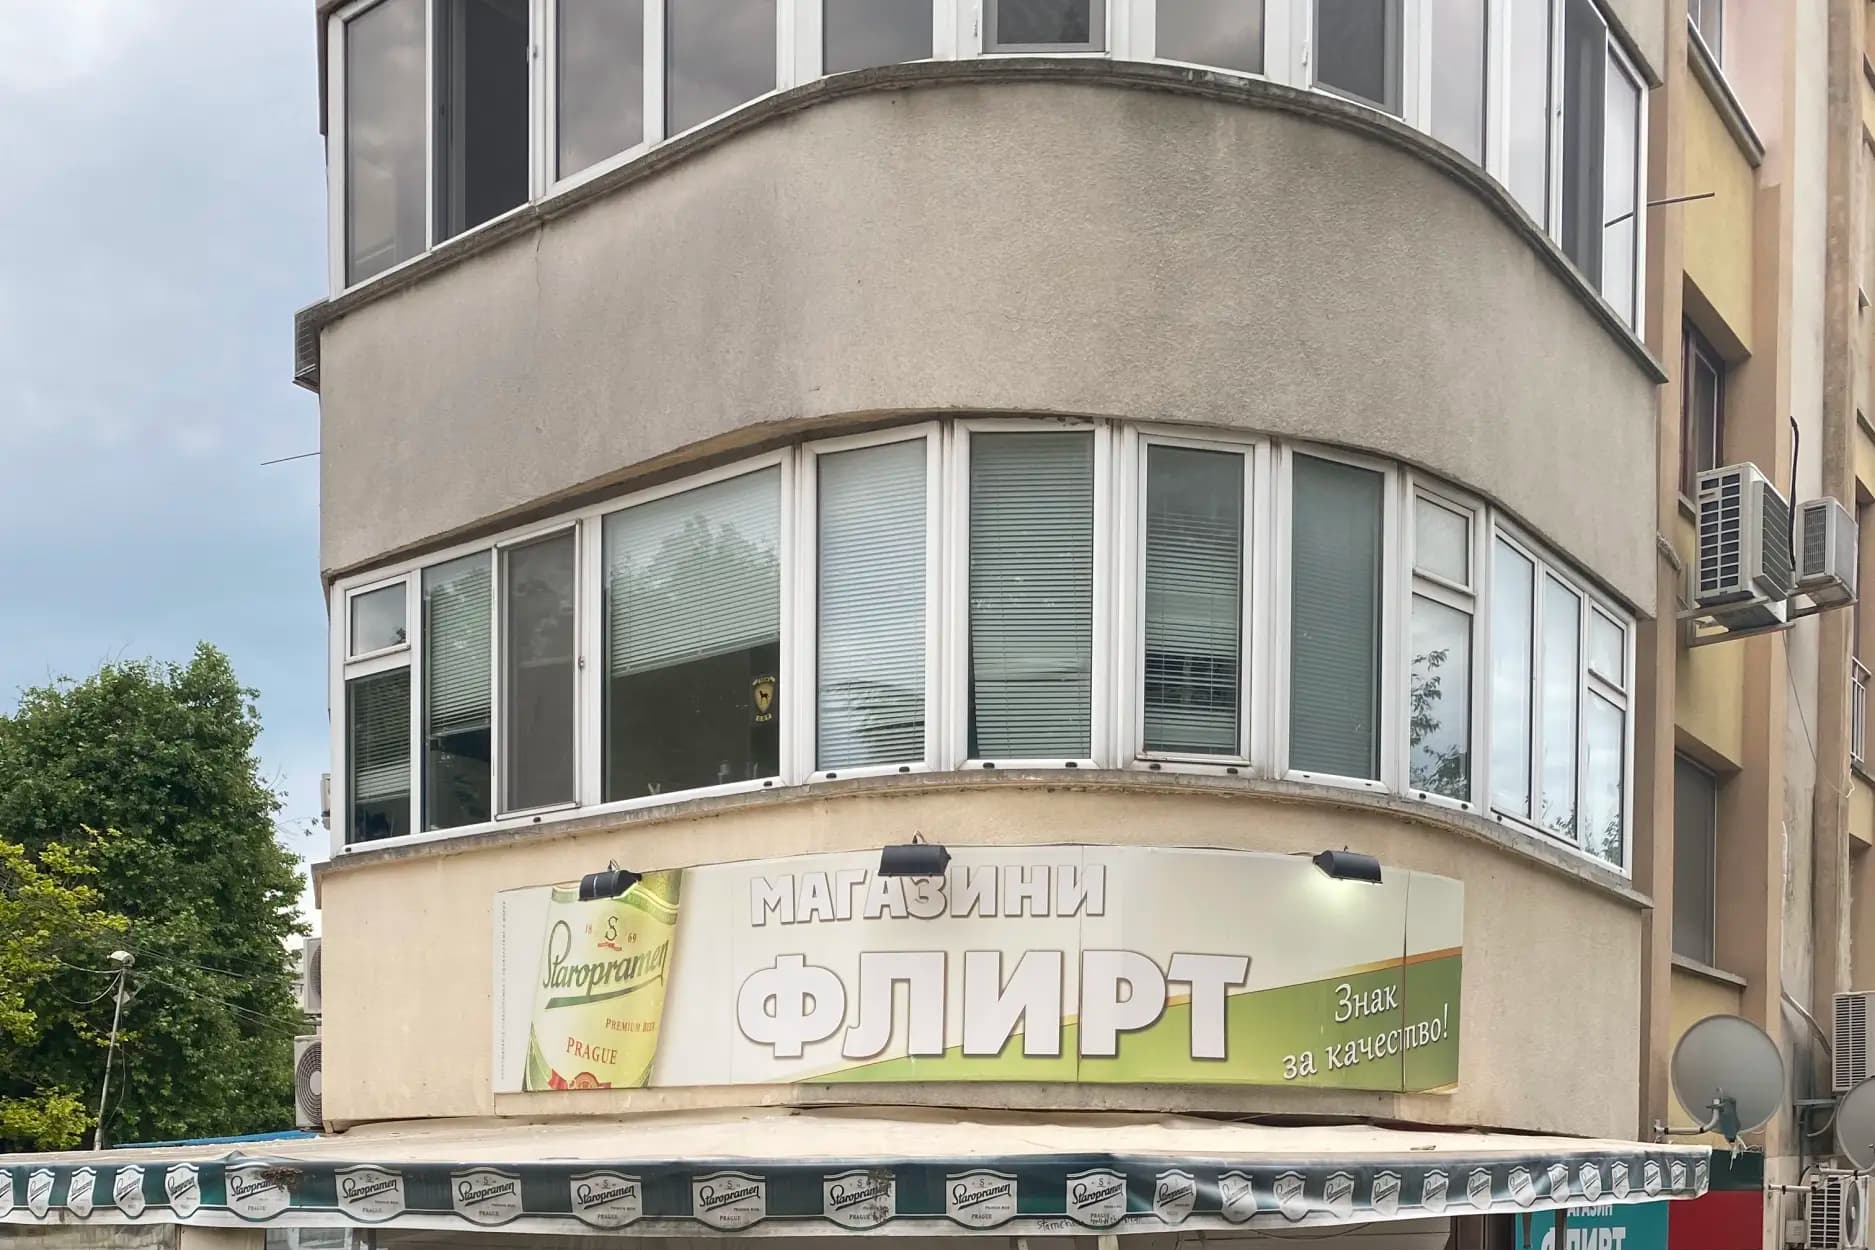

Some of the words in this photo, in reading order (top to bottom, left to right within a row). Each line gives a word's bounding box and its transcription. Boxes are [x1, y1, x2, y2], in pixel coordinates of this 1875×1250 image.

[750, 863, 1106, 927] МАГАЗИНИ
[542, 920, 669, 998] Staropramen
[737, 949, 1250, 1062] ФЛИРТ
[1334, 982, 1399, 1023] Знак
[605, 1017, 641, 1033] PREMIUM
[566, 1036, 619, 1065] PRAGUE
[1283, 1051, 1317, 1080] за
[1327, 1003, 1450, 1071] качество!
[342, 1177, 398, 1199] Staropramen
[458, 1180, 516, 1202] Staropramen
[577, 1183, 636, 1205] Staropramen
[699, 1184, 760, 1207] Staropramen
[952, 1183, 1011, 1205] Staropramen
[1072, 1183, 1124, 1205] Staropramen
[1567, 1203, 1613, 1217] АГАЗИН
